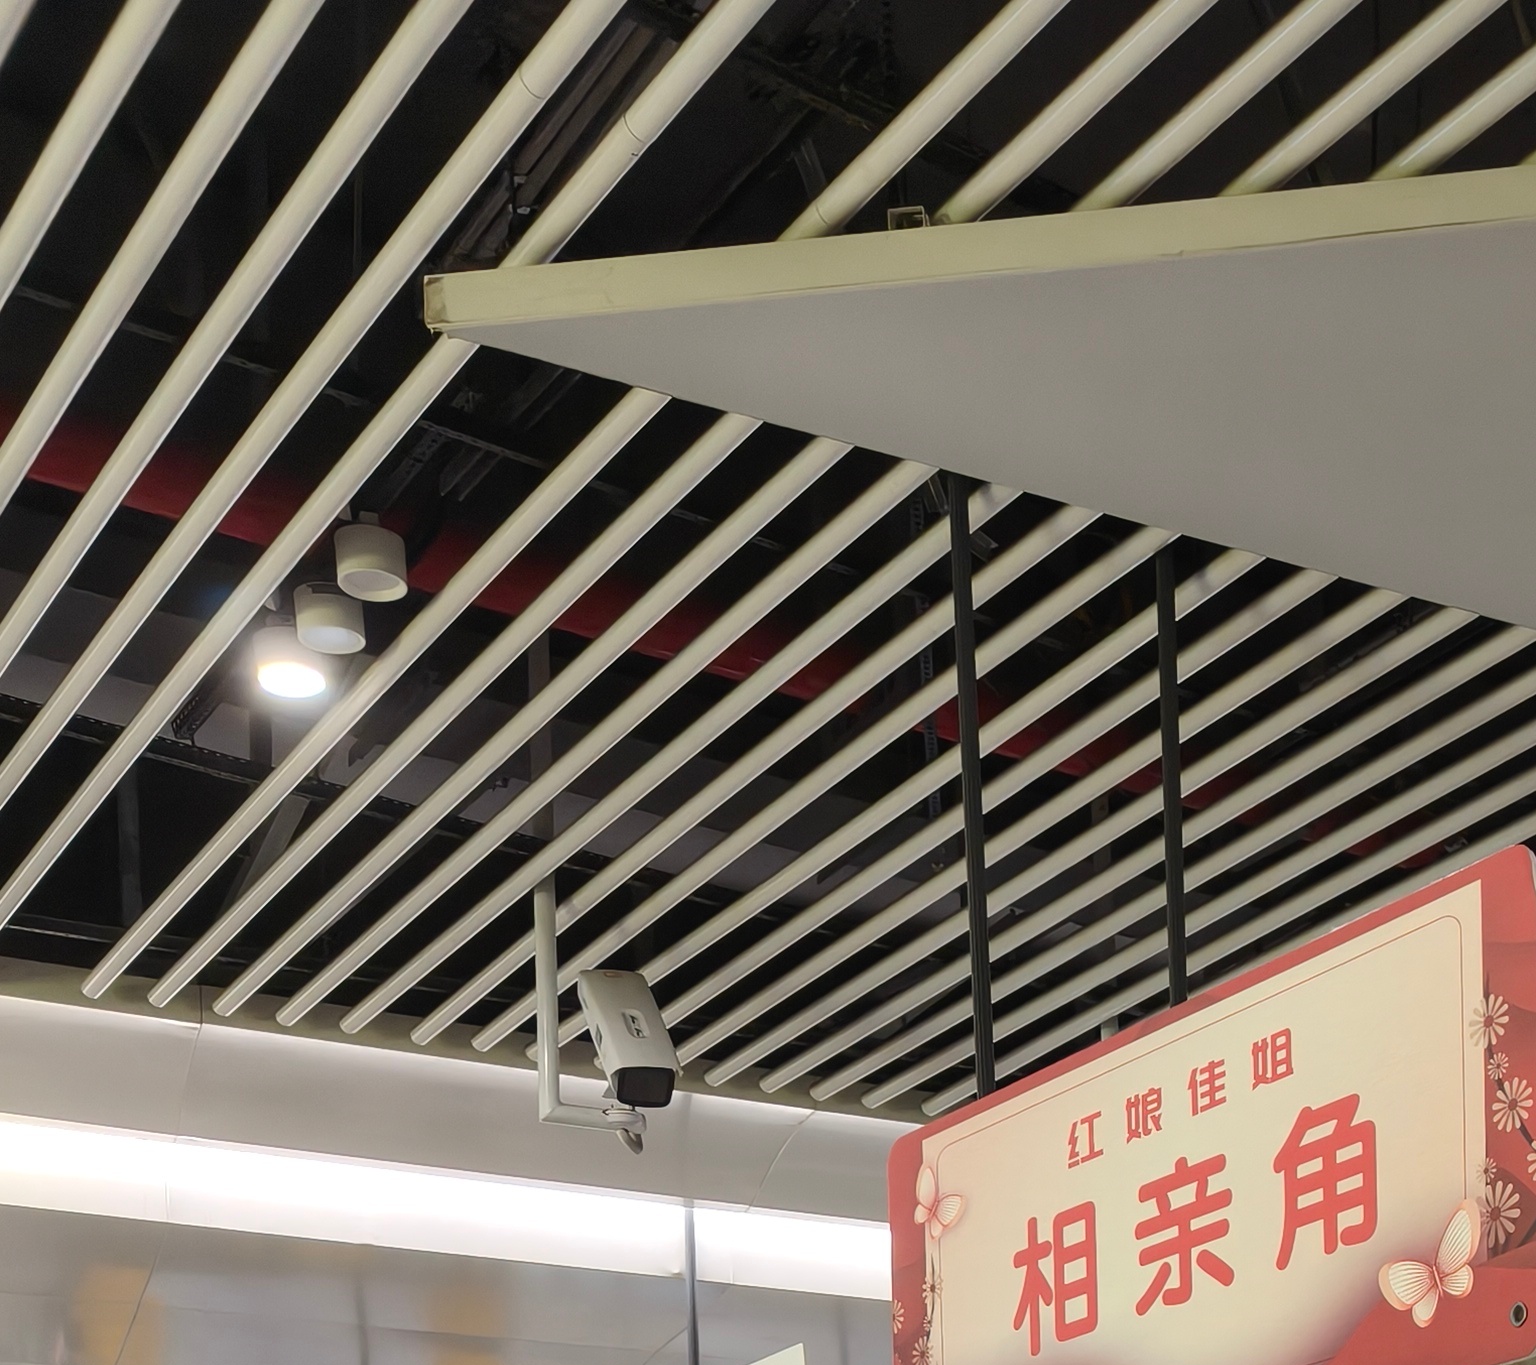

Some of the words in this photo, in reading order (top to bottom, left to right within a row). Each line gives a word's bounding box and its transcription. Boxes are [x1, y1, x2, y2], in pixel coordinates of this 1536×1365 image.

[1067, 1028, 1294, 1170] 红娘佳姐
[1012, 1093, 1379, 1357] 相亲角
